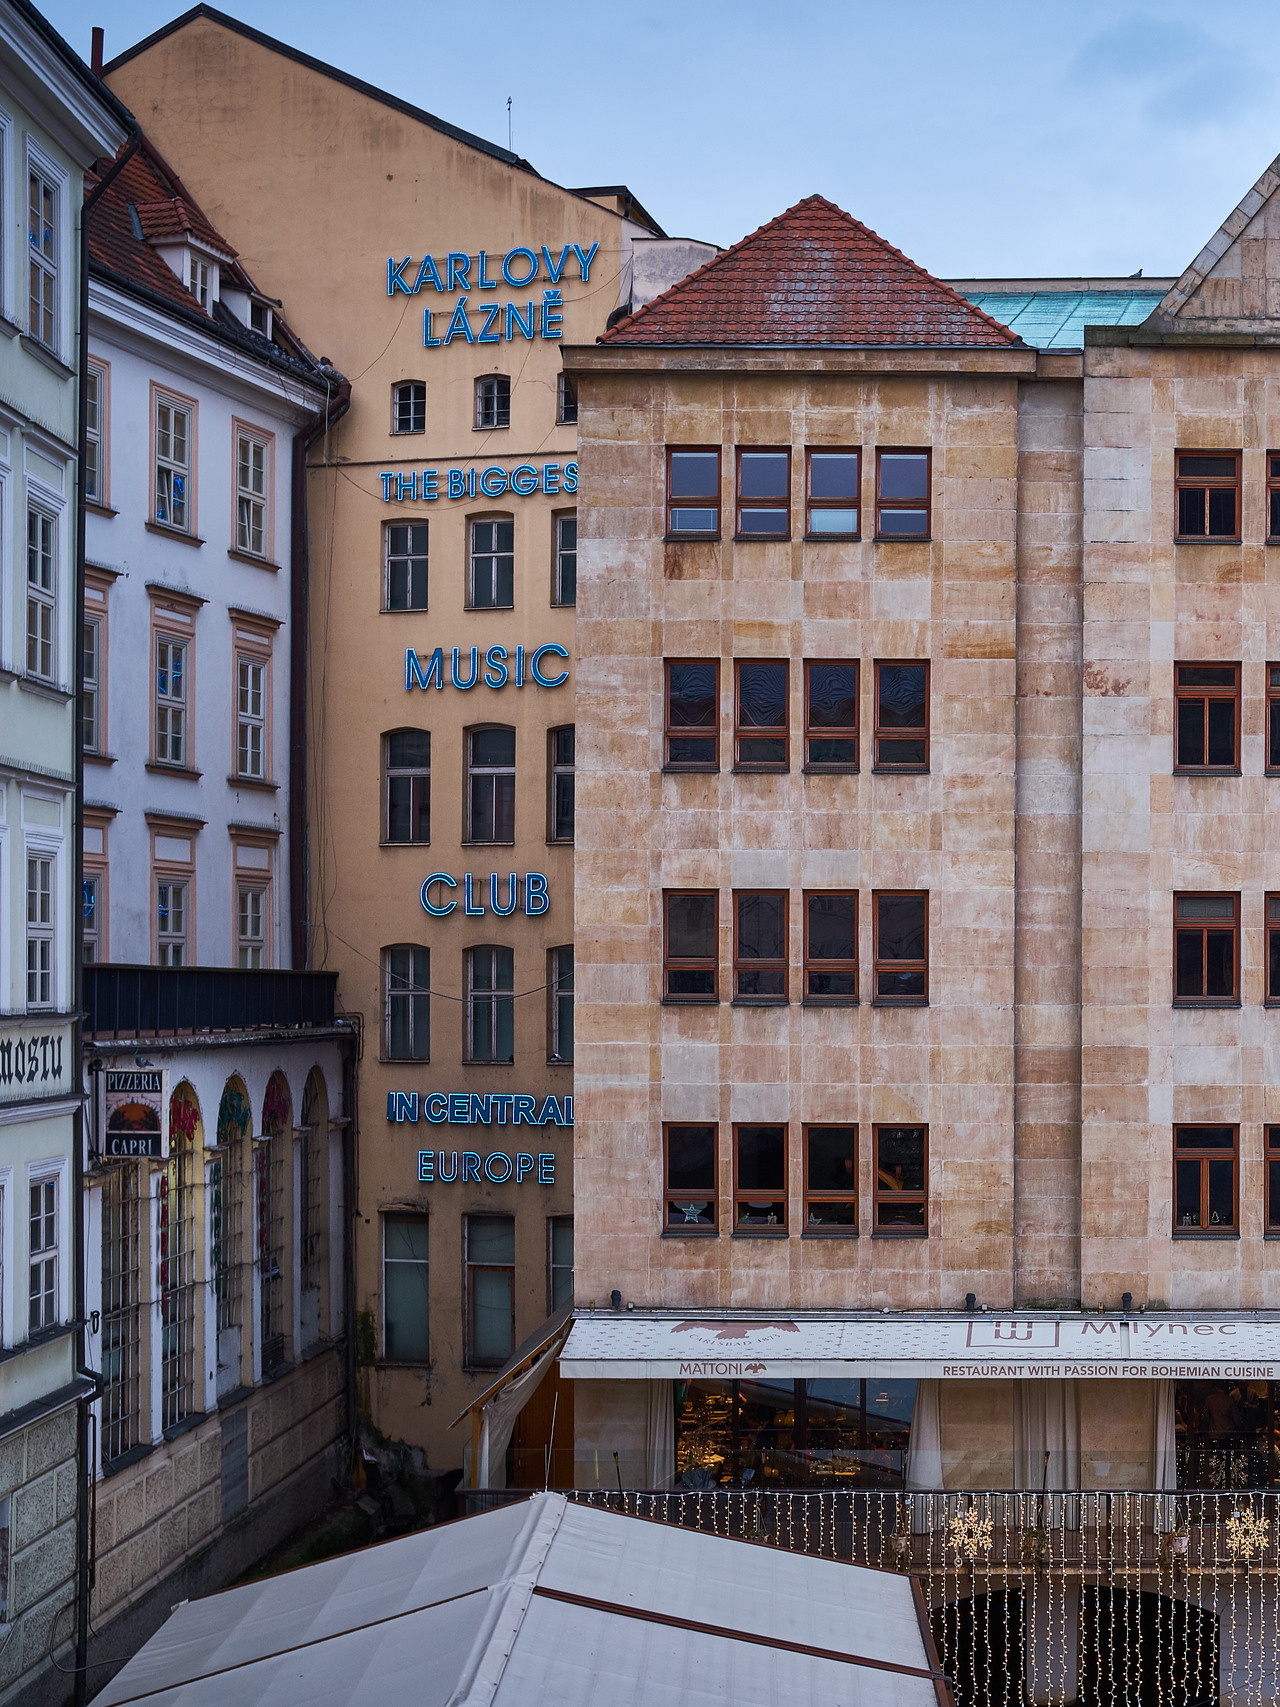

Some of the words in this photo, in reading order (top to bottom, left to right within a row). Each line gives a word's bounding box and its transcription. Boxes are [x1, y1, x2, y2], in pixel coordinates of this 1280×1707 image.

[387, 242, 600, 296] KARLOVY
[423, 289, 563, 347] LÁZNĚ
[379, 469, 438, 502] THE
[405, 643, 569, 690] MUSIC
[420, 872, 549, 916] CLUB
[107, 1073, 161, 1091] PIZZERIA
[387, 1092, 418, 1123] IN
[424, 1092, 574, 1126] CENTRAL
[111, 1139, 153, 1155] CAPRI
[418, 1151, 555, 1184] EUROPE
[679, 1363, 742, 1375] MATTONI
[943, 1366, 1024, 1376] RESTAURANT
[1027, 1366, 1060, 1376] WITH
[1064, 1366, 1118, 1376] PASSION
[1122, 1366, 1147, 1376] FOR
[1151, 1366, 1220, 1377] BOHEMIAN
[1224, 1367, 1274, 1377] CUISINE
